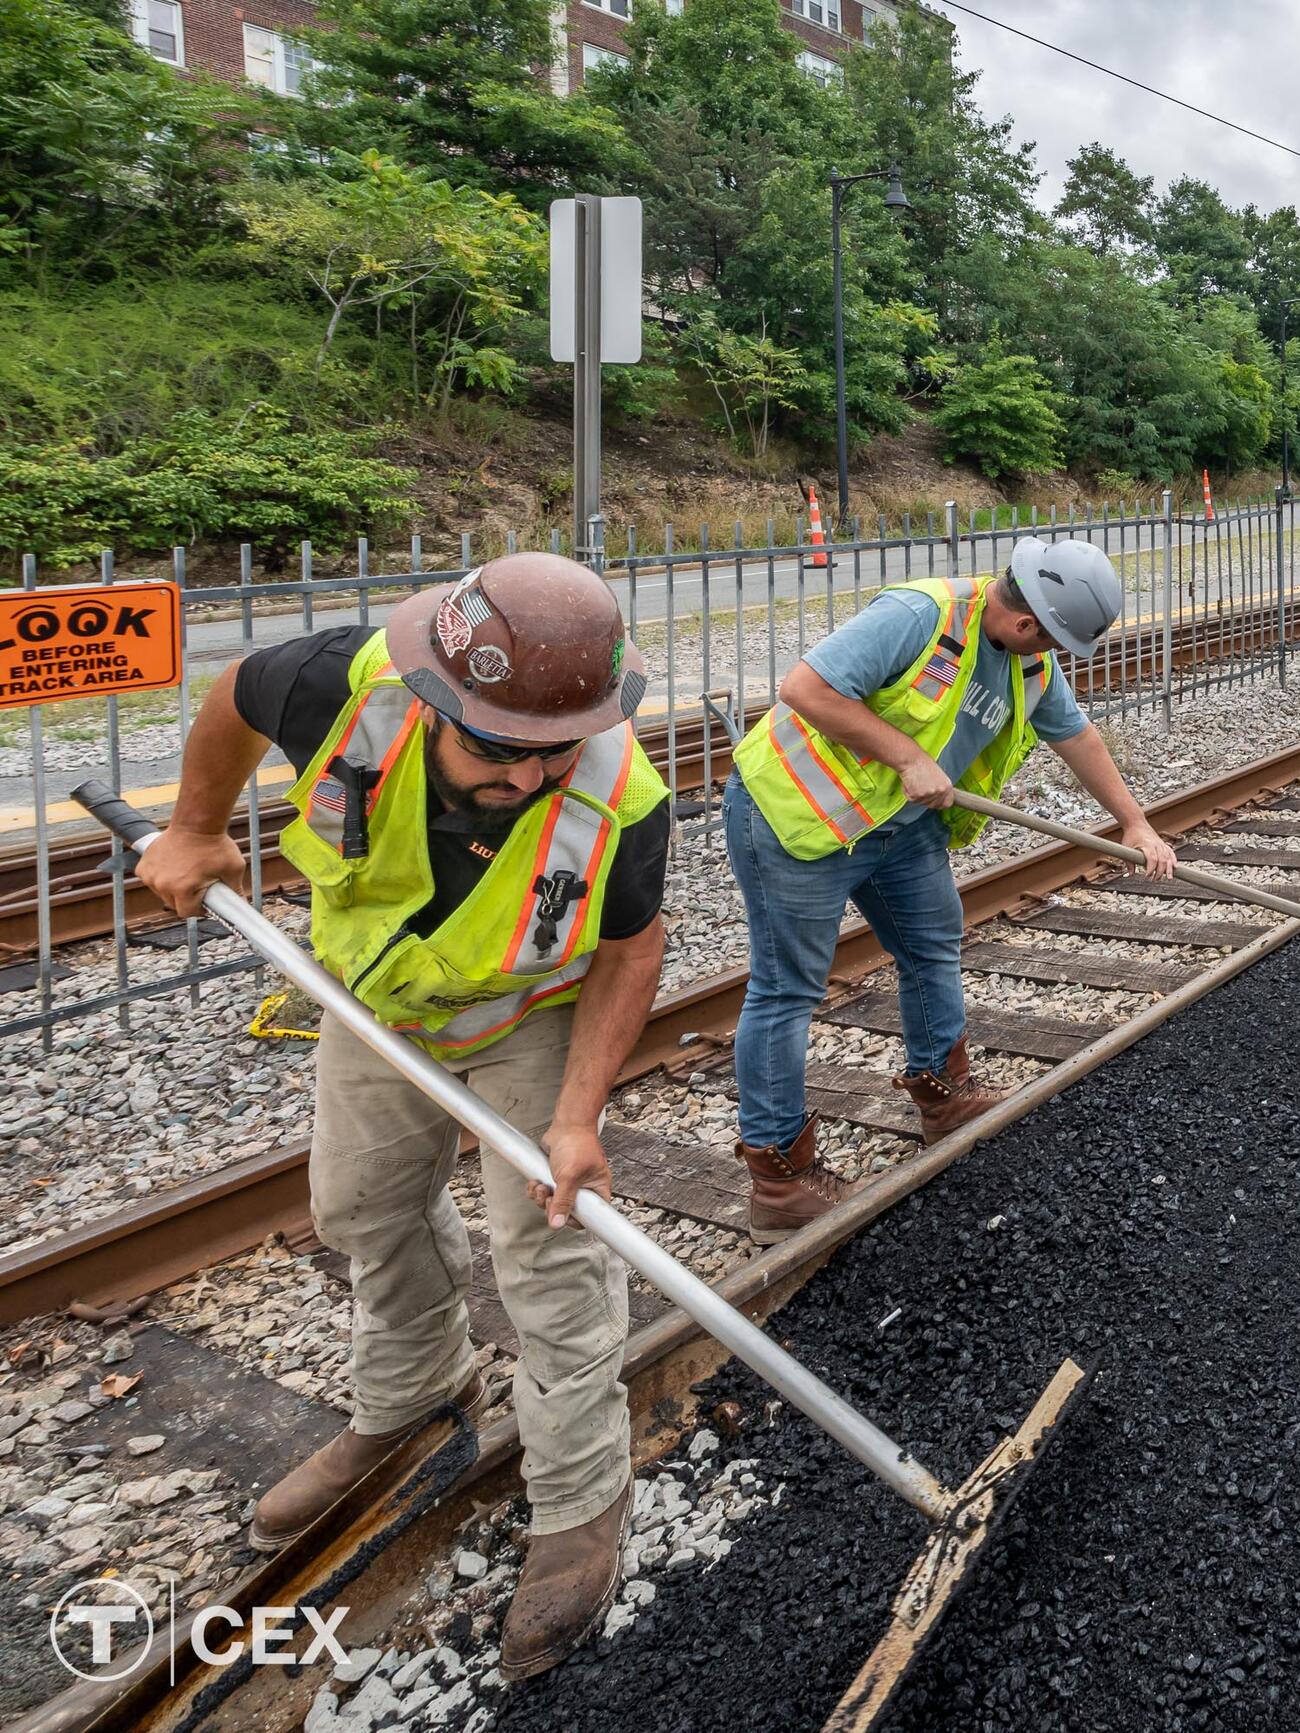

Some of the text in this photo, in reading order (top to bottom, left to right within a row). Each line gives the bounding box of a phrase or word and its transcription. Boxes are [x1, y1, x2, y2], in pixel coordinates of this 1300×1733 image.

[22, 641, 116, 663] BEFORE
[470, 650, 508, 678] BARLETTA
[10, 655, 128, 680] ENTERING
[83, 668, 144, 686] AREA
[960, 681, 990, 717] ILL
